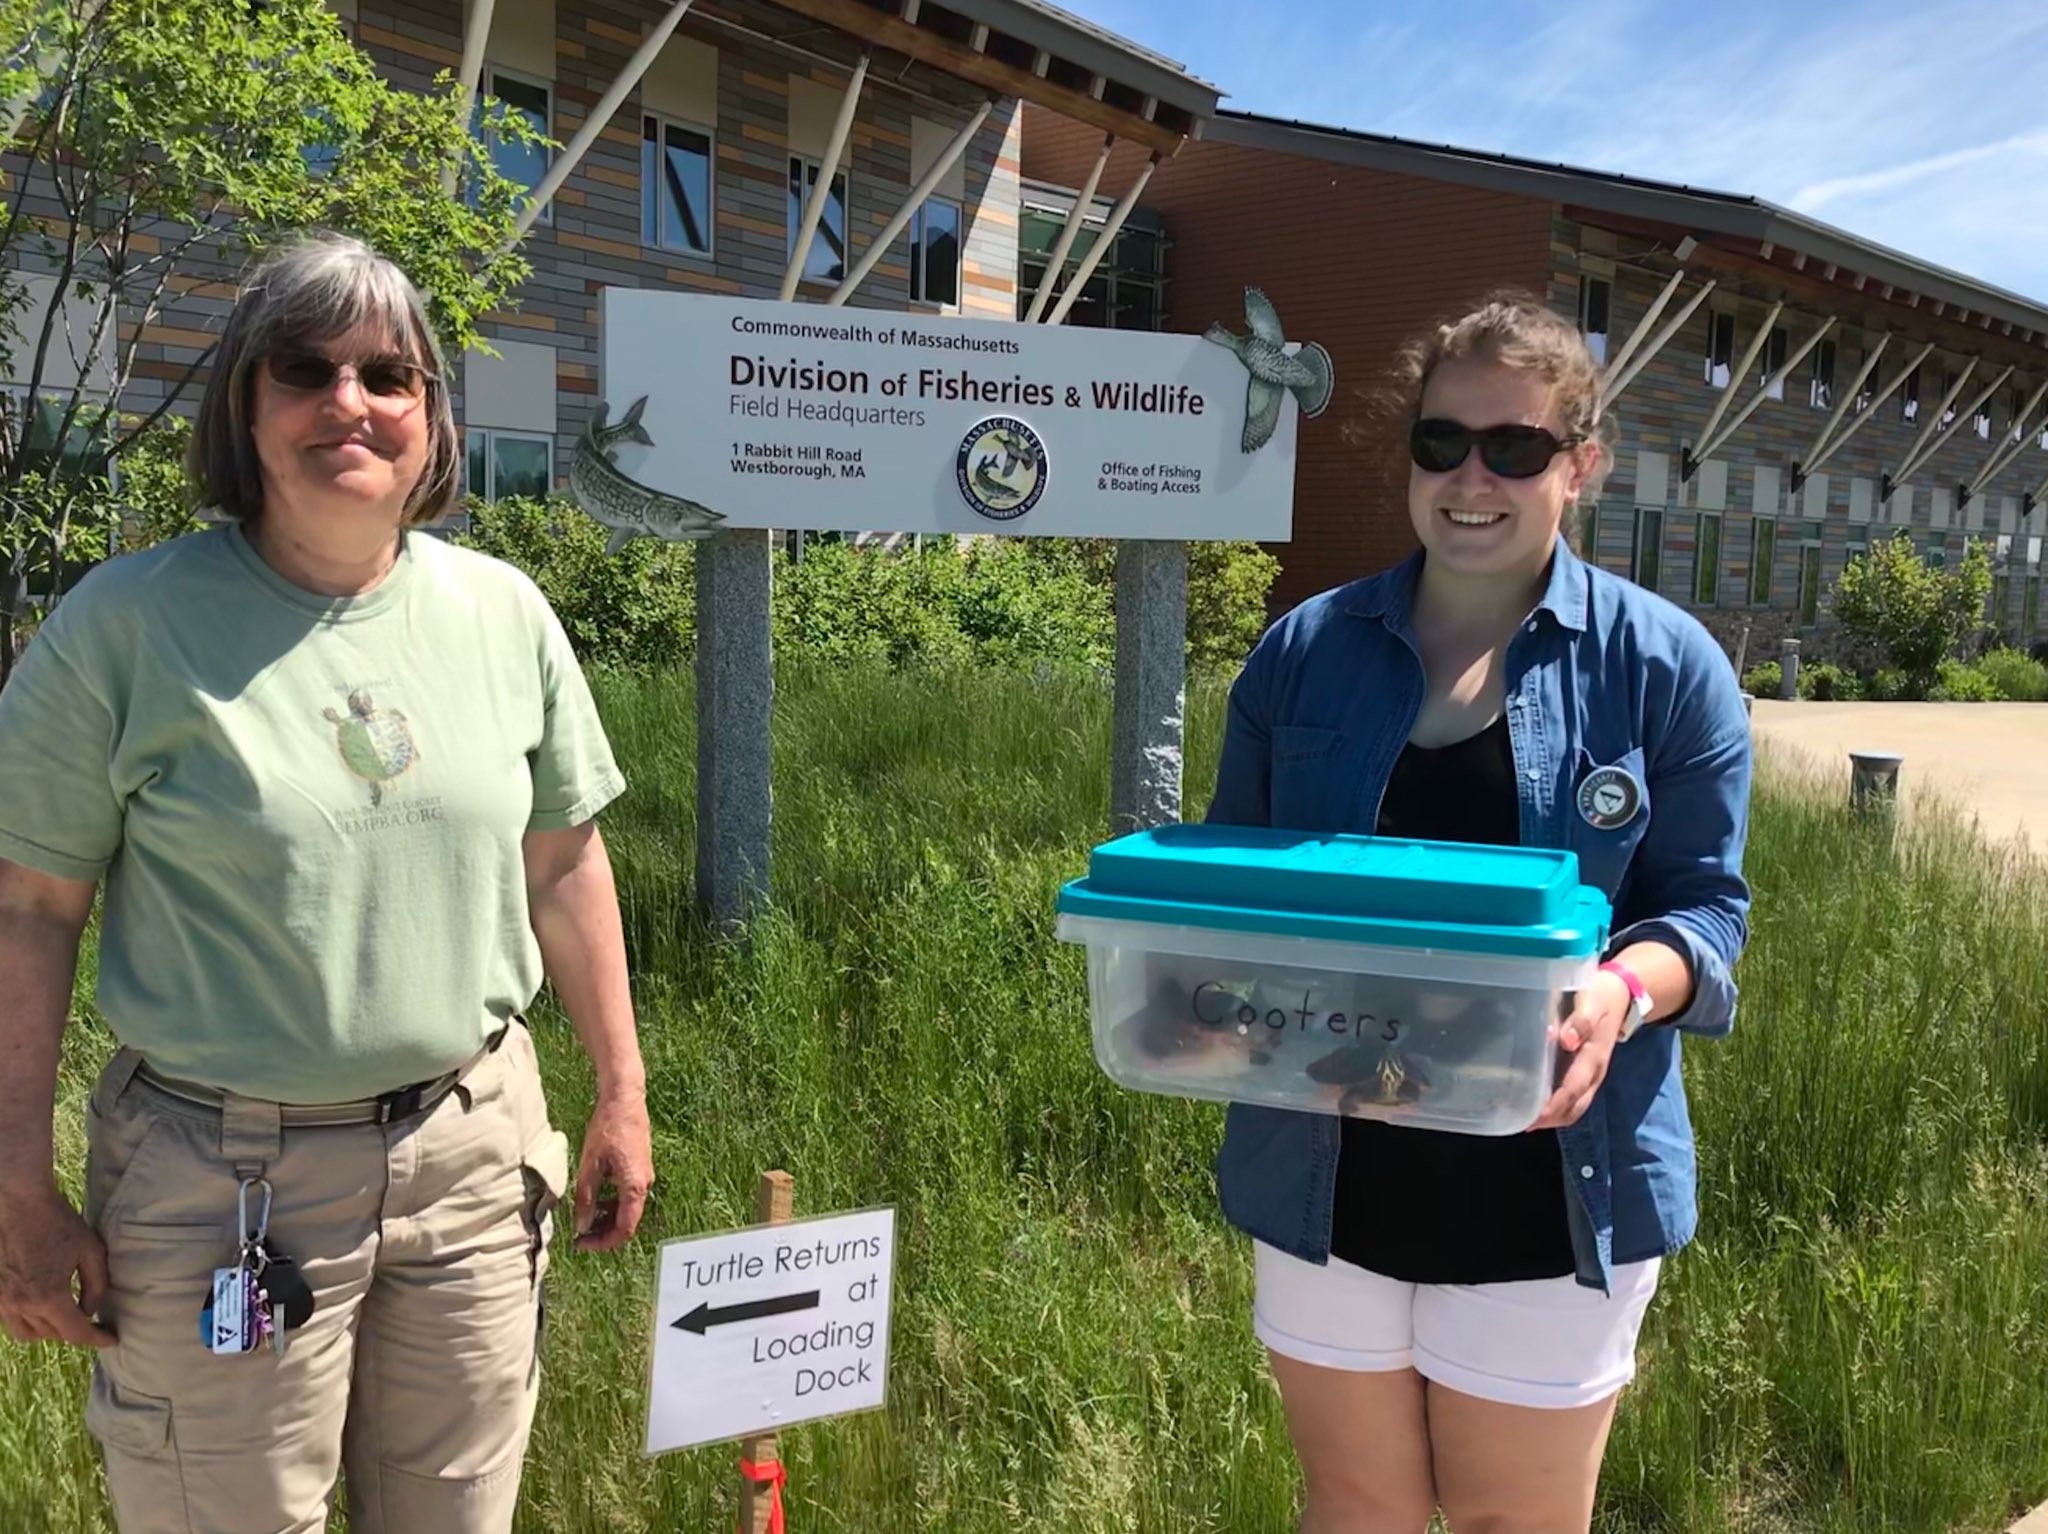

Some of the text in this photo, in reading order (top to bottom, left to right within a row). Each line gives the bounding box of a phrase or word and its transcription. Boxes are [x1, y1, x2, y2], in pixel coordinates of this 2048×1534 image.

[732, 317, 1019, 353] Commonwealth of Massachusetts
[731, 356, 1203, 415] Division of Fisheries & Wildlife
[730, 395, 925, 427] Field Headquarters
[733, 443, 861, 462] 1 Rabbit Hill Road
[961, 420, 1044, 459] MASSACHUSETTS
[731, 460, 865, 479] Westborough, MA
[1098, 478, 1200, 495] & Boating Access
[1102, 462, 1201, 483] Office of Fishing
[1193, 980, 1399, 1041] Cooters
[683, 1237, 880, 1288] Turtle Returns
[848, 1274, 878, 1302] at
[753, 1321, 874, 1362] Loading
[795, 1358, 871, 1396] Dock
